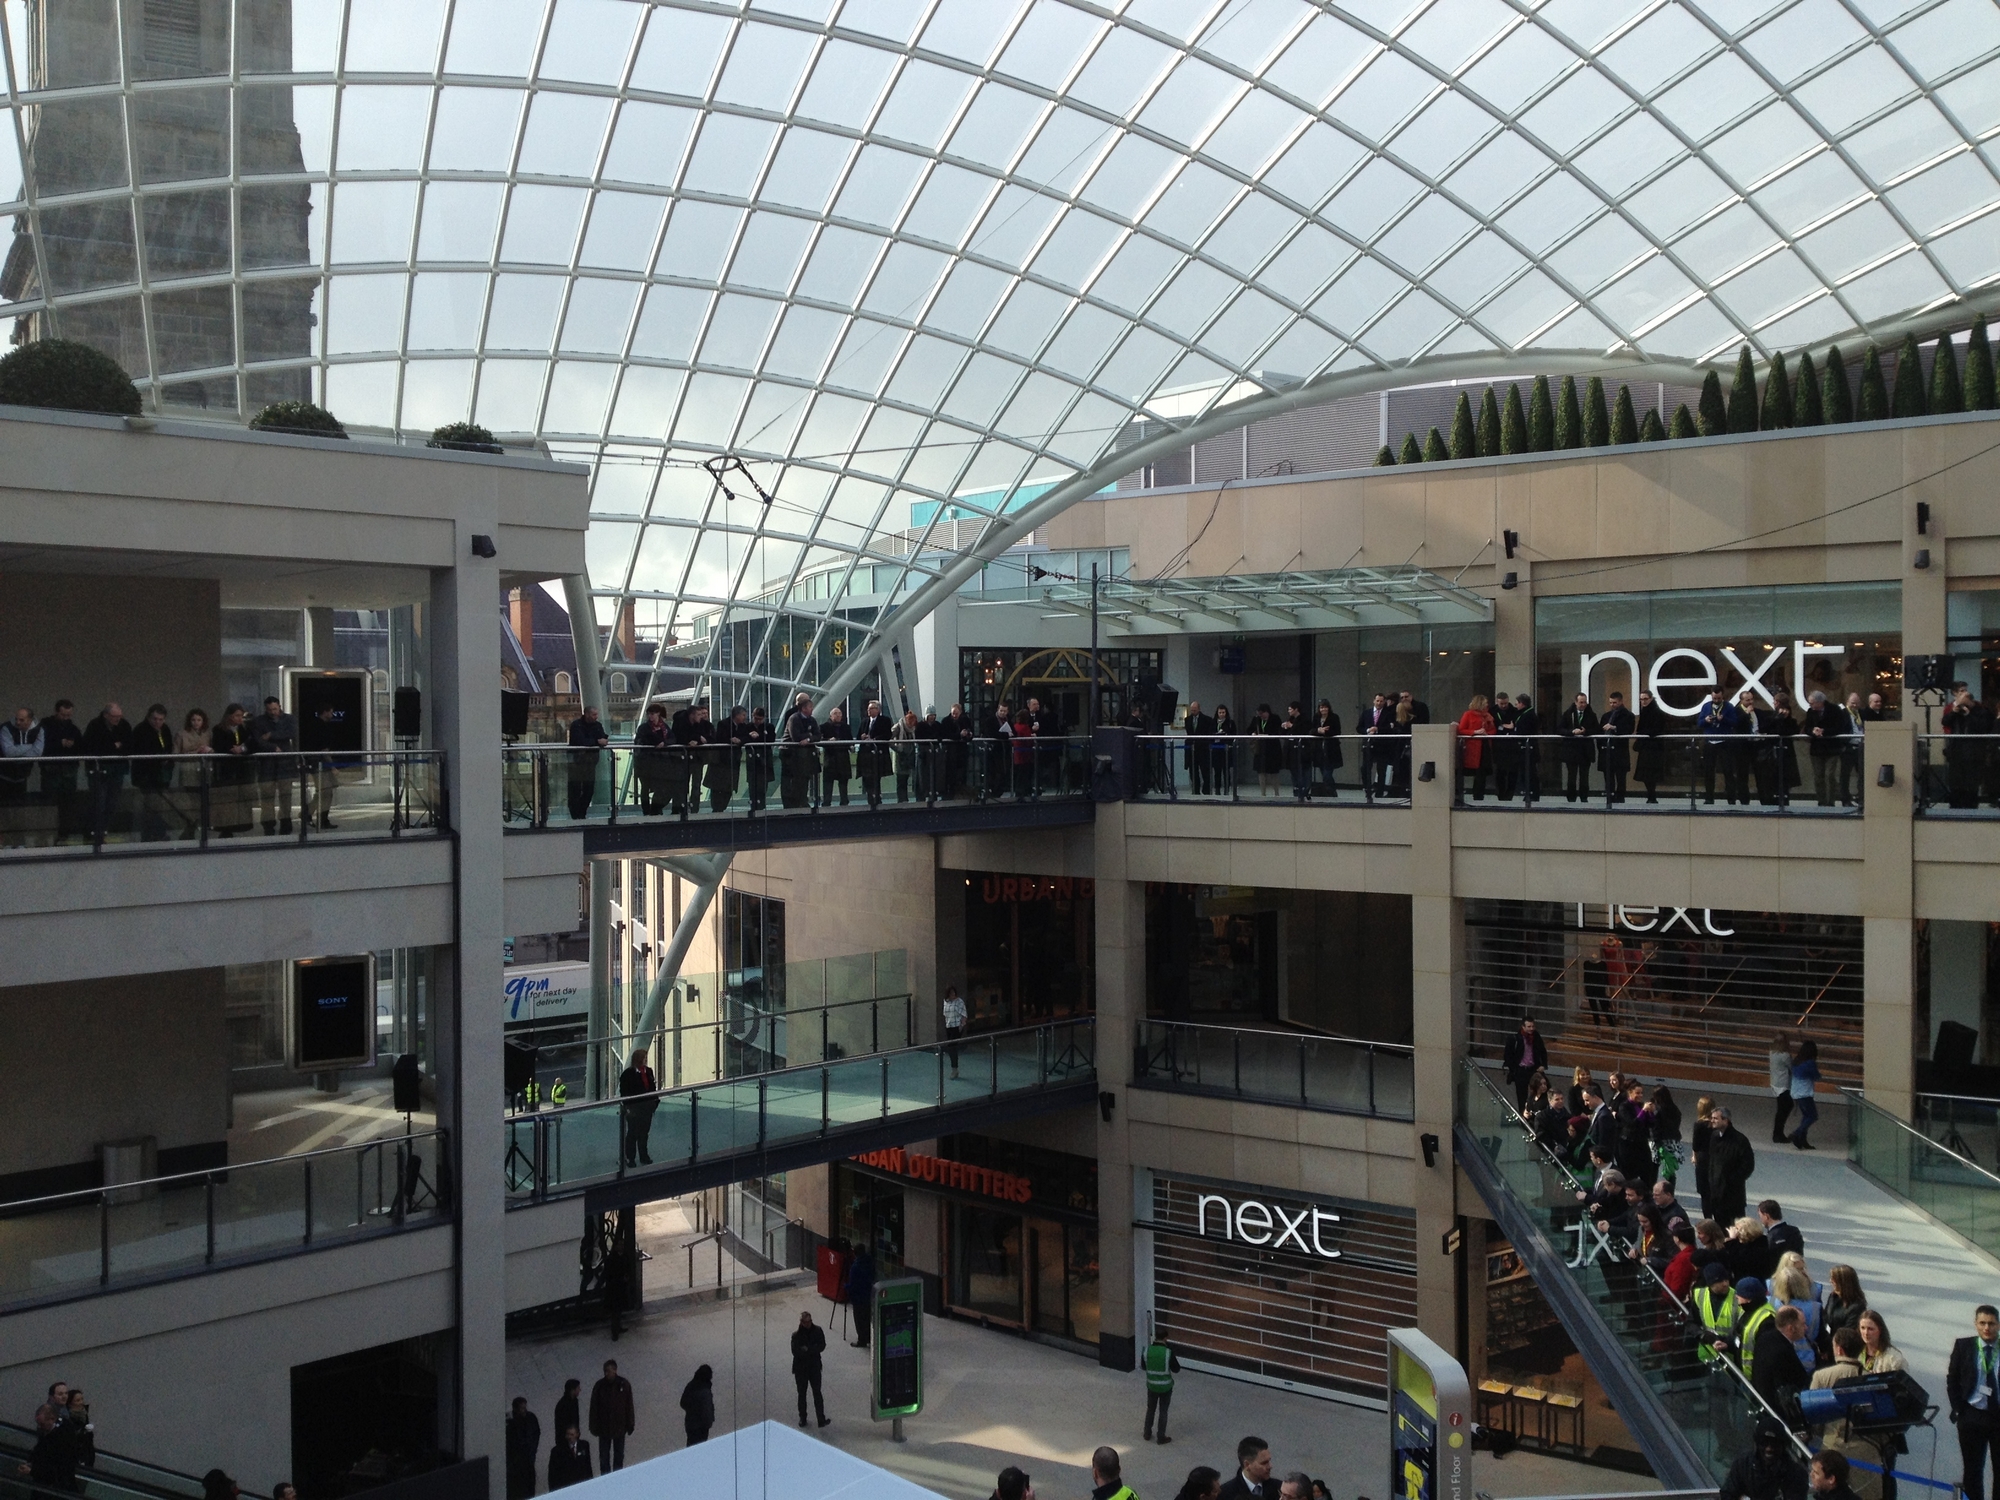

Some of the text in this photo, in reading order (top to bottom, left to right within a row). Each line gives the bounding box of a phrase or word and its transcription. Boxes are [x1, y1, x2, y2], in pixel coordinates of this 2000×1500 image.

[1580, 640, 1845, 717] next
[983, 873, 1074, 904] URBAN
[318, 996, 348, 1005] SONY
[536, 997, 568, 1007] delivery
[543, 987, 561, 997] next
[563, 986, 577, 996] day
[908, 1153, 1032, 1203] OUTFITTERS
[1199, 1195, 1342, 1258] next
[1451, 1455, 1461, 1484] Floor
